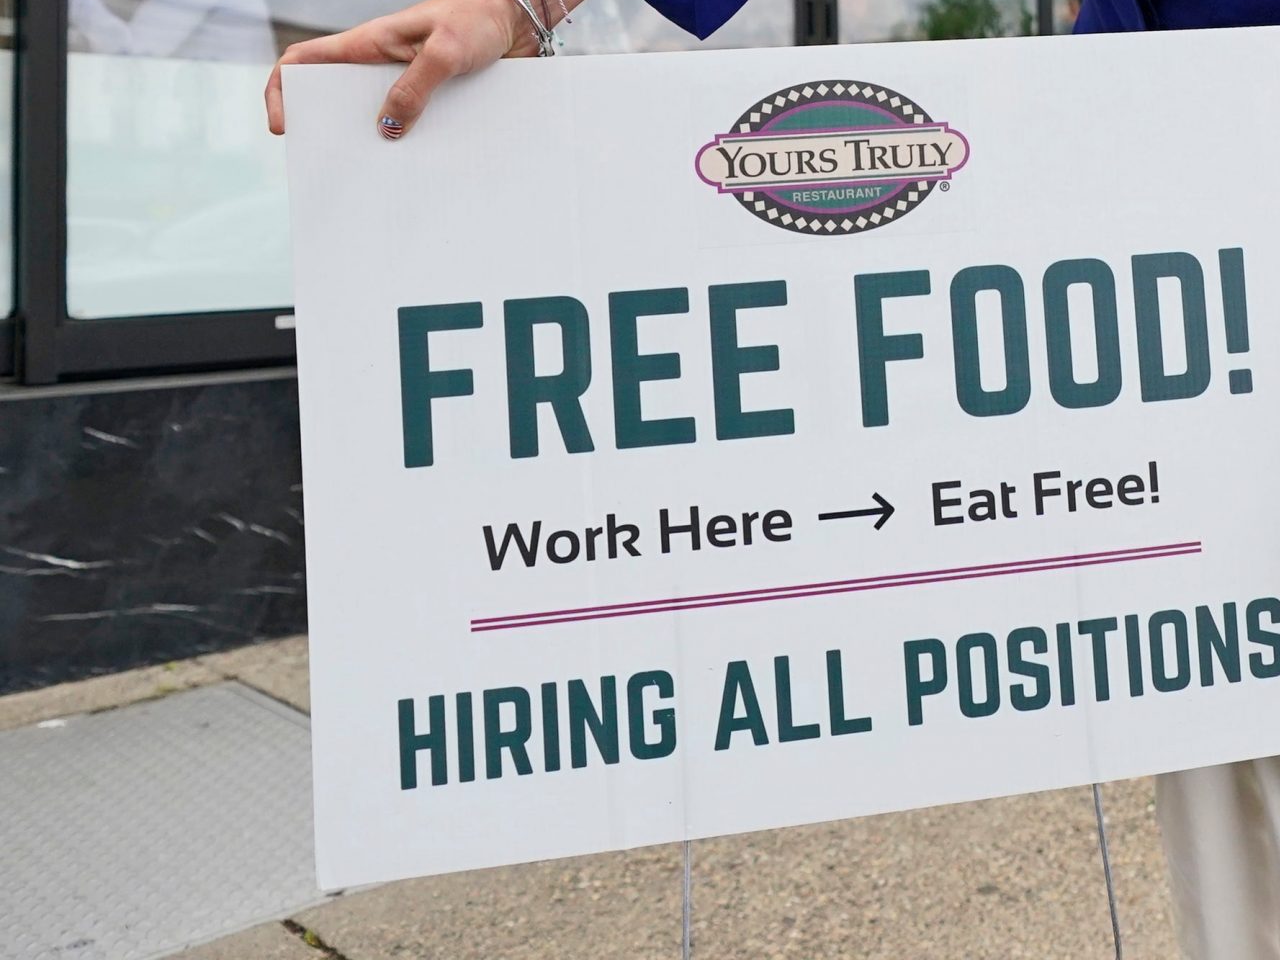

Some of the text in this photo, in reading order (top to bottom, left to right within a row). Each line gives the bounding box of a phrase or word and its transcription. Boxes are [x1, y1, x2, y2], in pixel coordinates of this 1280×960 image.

[715, 138, 954, 180] YOURS TRULY
[791, 186, 883, 204] RESTAURANT
[398, 246, 1254, 469] FREE FOOD!
[483, 460, 1160, 571] Work Here Eat Free!
[398, 669, 677, 791] HIRING
[714, 649, 873, 752] ALL
